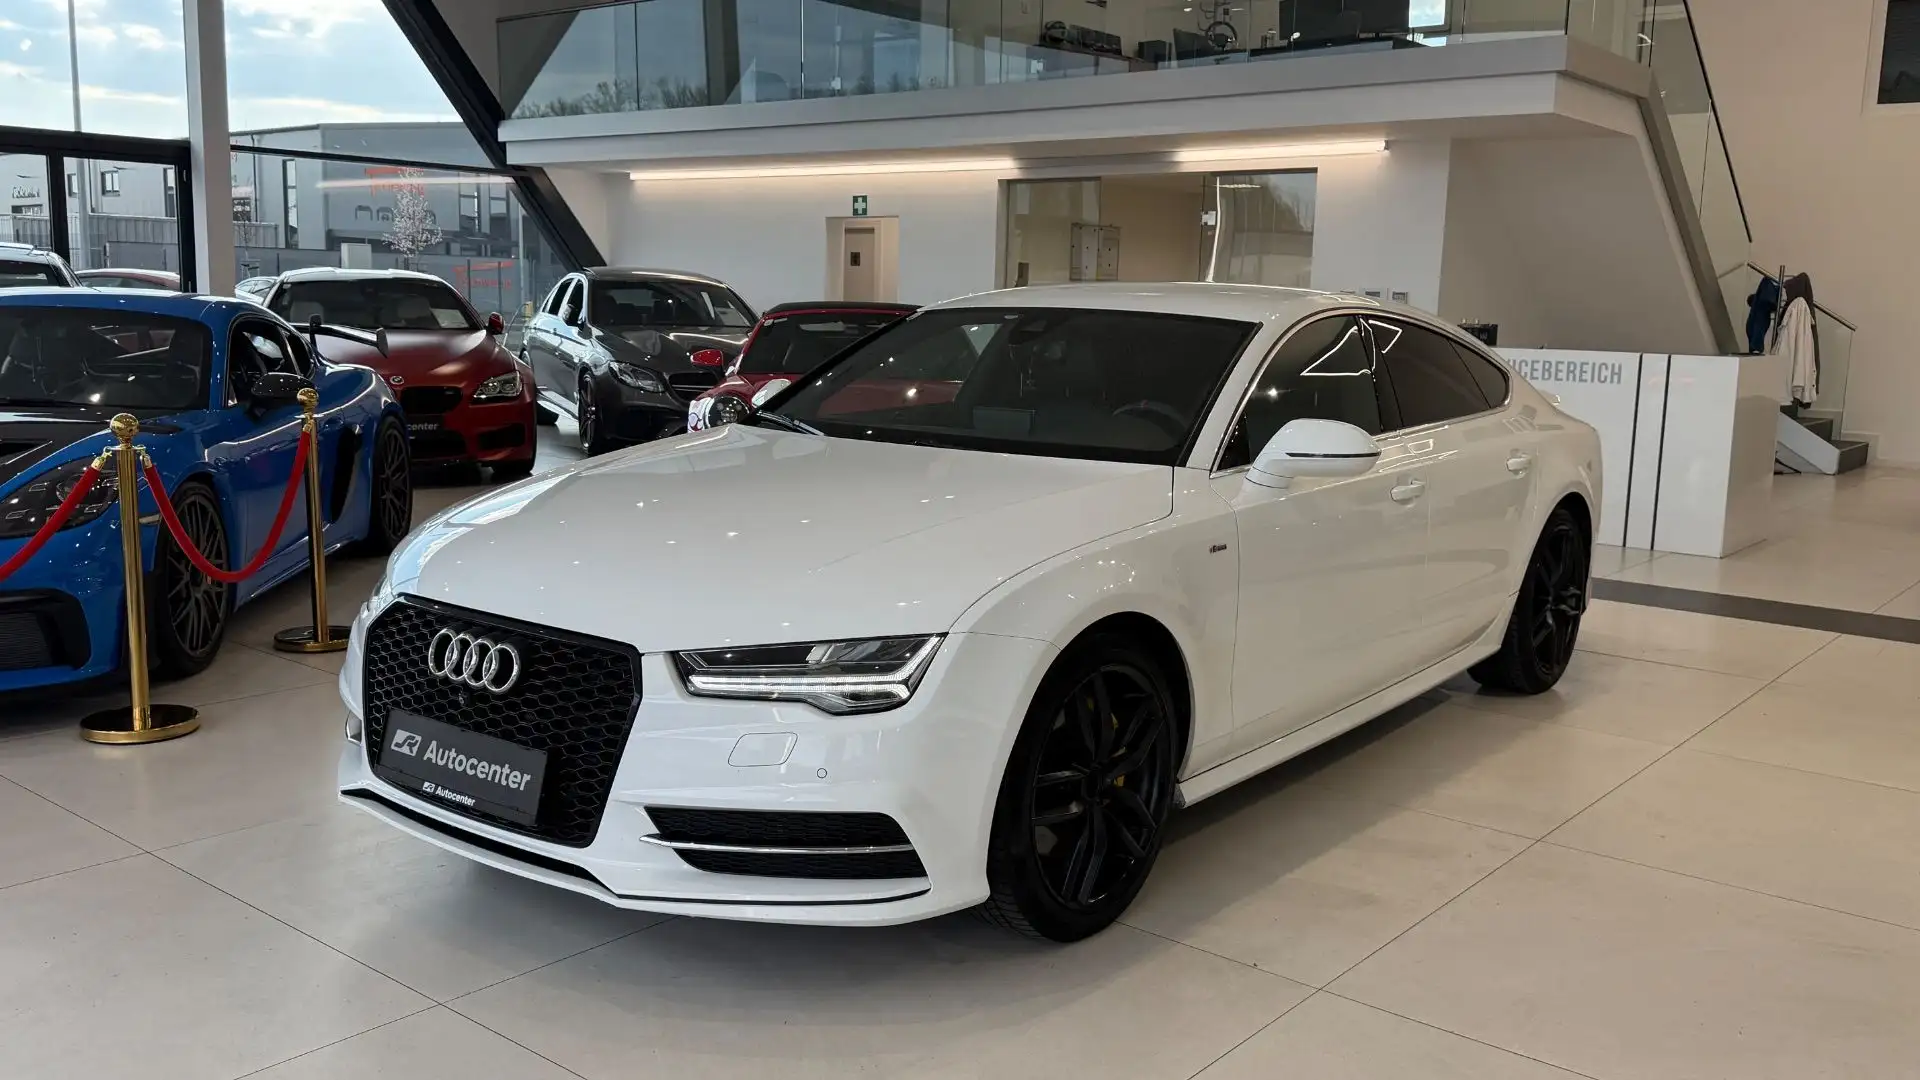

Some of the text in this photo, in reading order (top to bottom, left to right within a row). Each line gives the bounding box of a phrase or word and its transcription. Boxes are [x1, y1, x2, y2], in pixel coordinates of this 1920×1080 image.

[1507, 358, 1622, 385] ICEBEREICH
[423, 740, 531, 791] Autocenter
[435, 786, 476, 806] Autocenter
